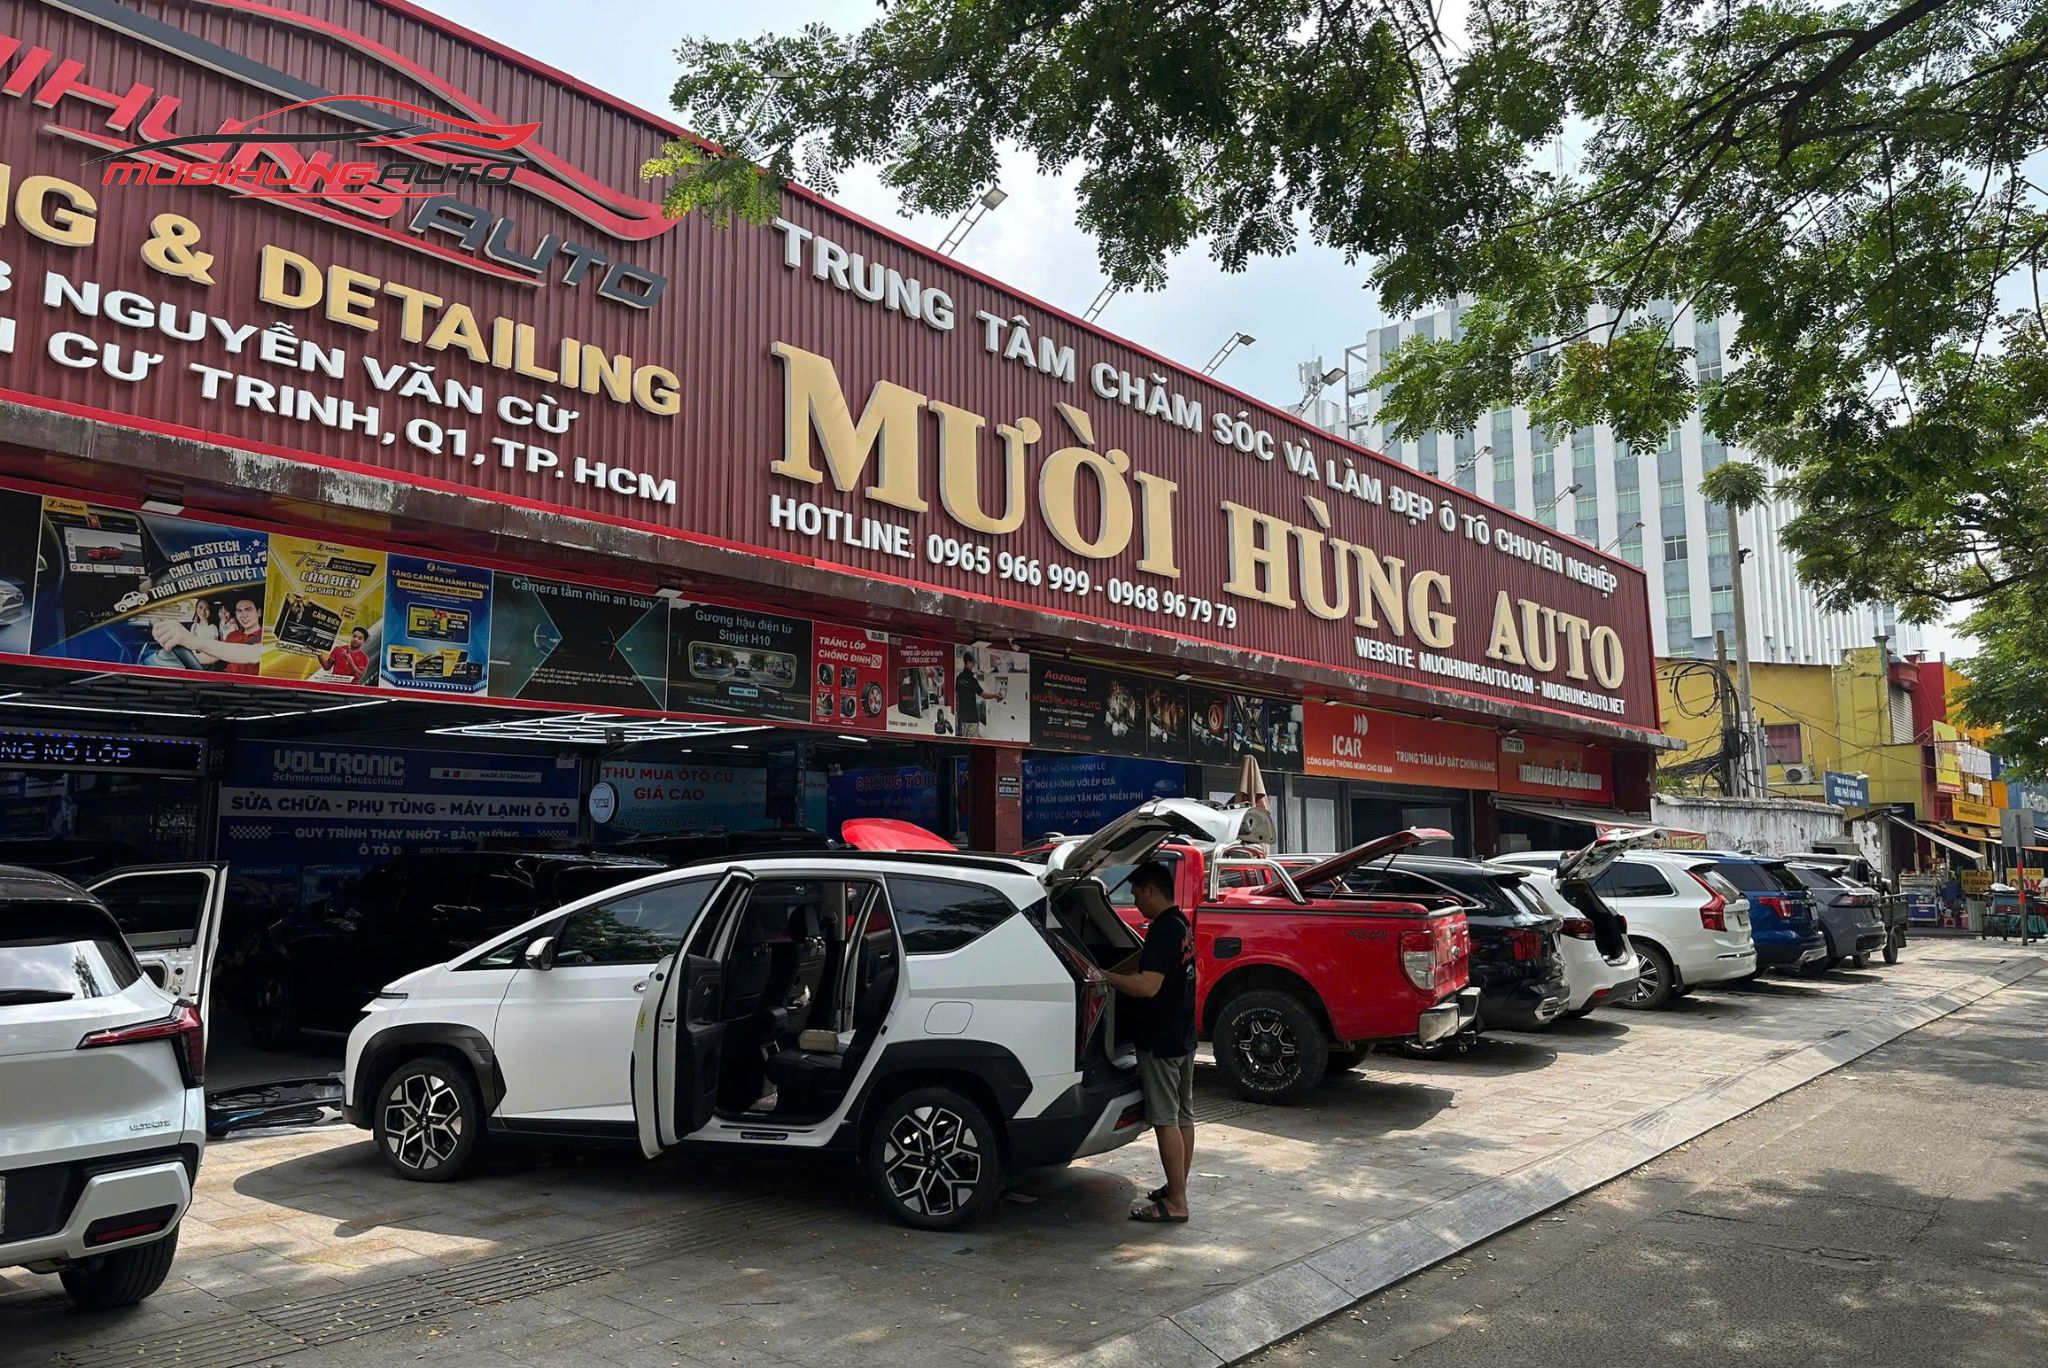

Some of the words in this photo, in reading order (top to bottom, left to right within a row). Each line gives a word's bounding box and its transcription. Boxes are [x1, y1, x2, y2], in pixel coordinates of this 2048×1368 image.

[0, 34, 410, 219] IHUNG
[408, 196, 667, 309] AUTO
[141, 212, 216, 286] &
[260, 244, 682, 416] DETAILING
[44, 271, 345, 380] NGUYỄN
[364, 355, 482, 415] VĂN
[498, 394, 579, 433] CỪ
[772, 216, 954, 330] TRUNG
[976, 310, 1075, 383] TÂM
[1091, 363, 1202, 433] CHĂM
[1212, 411, 1274, 461] SÓC
[1282, 438, 1319, 481] VÀ
[1325, 458, 1382, 505] LÀM
[1388, 485, 1434, 526] ĐẸP
[1439, 500, 1456, 532] Ô
[1460, 513, 1490, 545] TÔ
[1494, 528, 1563, 574] CHUYÊN
[1565, 557, 1617, 598] NGHIỆP
[48, 331, 164, 382] CƯ
[189, 363, 395, 445] TRINH,
[406, 418, 485, 466] Q1,
[492, 437, 564, 478] TP.
[574, 456, 676, 504] HCM
[771, 340, 1180, 578] MƯỜI
[1220, 494, 1456, 649] HÙNG
[1485, 590, 1625, 689] AUTO
[191, 541, 241, 557] ZESTECH
[168, 563, 194, 579] CHO
[413, 573, 444, 584] CAMERA
[927, 534, 990, 575] 0965
[997, 551, 1042, 586] 966
[1047, 564, 1090, 596] 999
[1107, 578, 1159, 612] 0968
[1162, 590, 1186, 618] 96
[1188, 596, 1212, 622] 79
[1215, 602, 1237, 629] 79
[512, 578, 558, 596] Camera
[613, 596, 626, 606] an
[695, 610, 733, 628] Gương
[719, 629, 748, 644] Sinjet
[751, 633, 771, 646] H10
[818, 636, 848, 648] TRÁNG
[849, 639, 866, 650] LỐP
[818, 648, 849, 660] CHỐNG
[850, 655, 871, 665] ĐINH
[1045, 670, 1087, 684] Aozoom
[1419, 652, 1534, 694] MUOIHUNGAUTO.COM
[1541, 681, 1625, 714] MUOIHUNGAUTO.NET
[1079, 699, 1101, 710] AUTO
[1332, 733, 1362, 758] ICAR
[273, 749, 405, 776] VOLTRONIC
[1307, 756, 1322, 767] CÔNG
[1336, 760, 1353, 769] THÔNG
[1396, 750, 1419, 764] TRUNG
[1419, 751, 1434, 765] TÂM
[603, 767, 635, 779] THU
[640, 768, 674, 781] MUA
[1071, 762, 1096, 772] NHANH
[272, 772, 343, 784] Schmierstoffe
[344, 775, 404, 786] Deutschland
[633, 784, 665, 800] GIÁ
[669, 788, 705, 801] CAO
[231, 791, 272, 811] SỬA
[277, 794, 331, 812] CHỮA
[347, 799, 384, 816] PHỤ
[389, 797, 436, 815] TÙNG
[450, 800, 485, 815] MÁY
[488, 804, 531, 819] LẠNH
[535, 802, 546, 817] Ô
[550, 802, 570, 817] TÔ
[294, 827, 324, 839] QUY
[327, 825, 368, 839] TRÌNH
[370, 828, 404, 839] THAY
[406, 826, 441, 840] NHỚT
[451, 826, 477, 840] BẢO
[358, 842, 369, 855] Ô
[371, 842, 390, 855] TÔ
